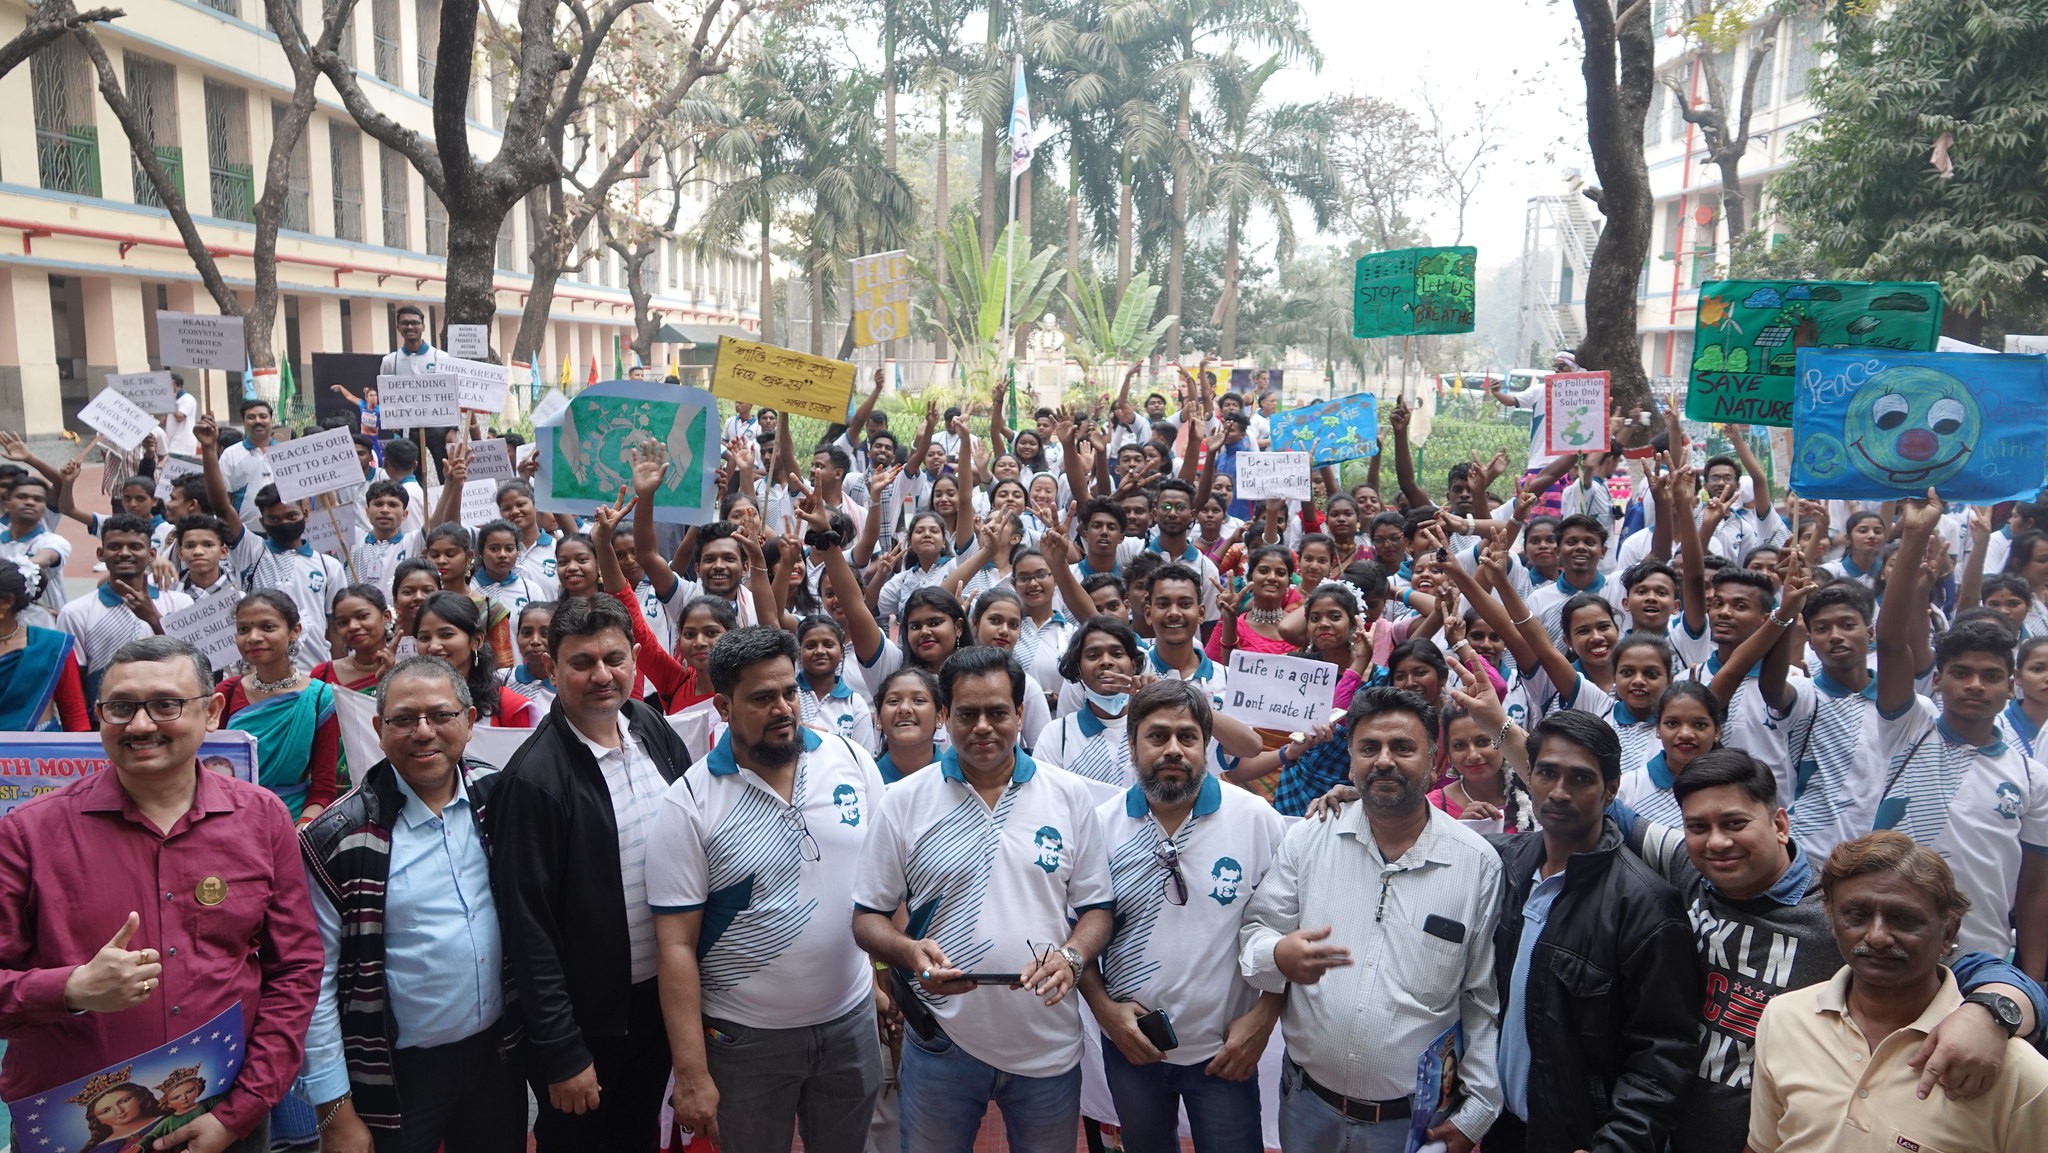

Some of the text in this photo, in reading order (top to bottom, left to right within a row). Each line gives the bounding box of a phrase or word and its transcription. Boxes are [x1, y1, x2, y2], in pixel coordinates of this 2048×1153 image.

[1361, 286, 1401, 304] STOP
[1414, 304, 1473, 325] BREATHE
[183, 318, 218, 327] HEALTY
[179, 329, 224, 337] ECOSYSTEM
[182, 339, 222, 347] PROMOTES
[440, 363, 467, 374] THINK
[123, 378, 135, 386] BE
[388, 380, 446, 389] DEFENDING
[460, 380, 490, 391] EEP IT
[1566, 380, 1604, 388] Pollution
[1696, 372, 1764, 394] SAVE
[1803, 358, 1887, 411] Peace
[150, 388, 167, 396] YOU
[383, 393, 454, 404] PEACE IS THE
[1582, 388, 1600, 397] Only
[114, 399, 142, 418] PEACE
[385, 408, 454, 418] DUTY OF ALL.
[1714, 397, 1793, 422] NATURE
[96, 403, 142, 436] BEGIN WITH
[92, 415, 127, 440] A SMILE
[271, 435, 350, 463] PEACE IS OUR
[276, 450, 354, 477] GIFT TO EACH
[299, 471, 340, 487] OTHER.
[1284, 475, 1295, 487] of
[218, 593, 237, 611] ARE
[181, 630, 203, 643] THE
[1275, 666, 1284, 680] is
[1289, 672, 1296, 681] a
[1299, 667, 1330, 696] gift
[1233, 691, 1264, 710] Dont
[1269, 700, 1299, 718] waste
[36, 758, 113, 777] MOVE
[1899, 1137, 1917, 1150] Lee
